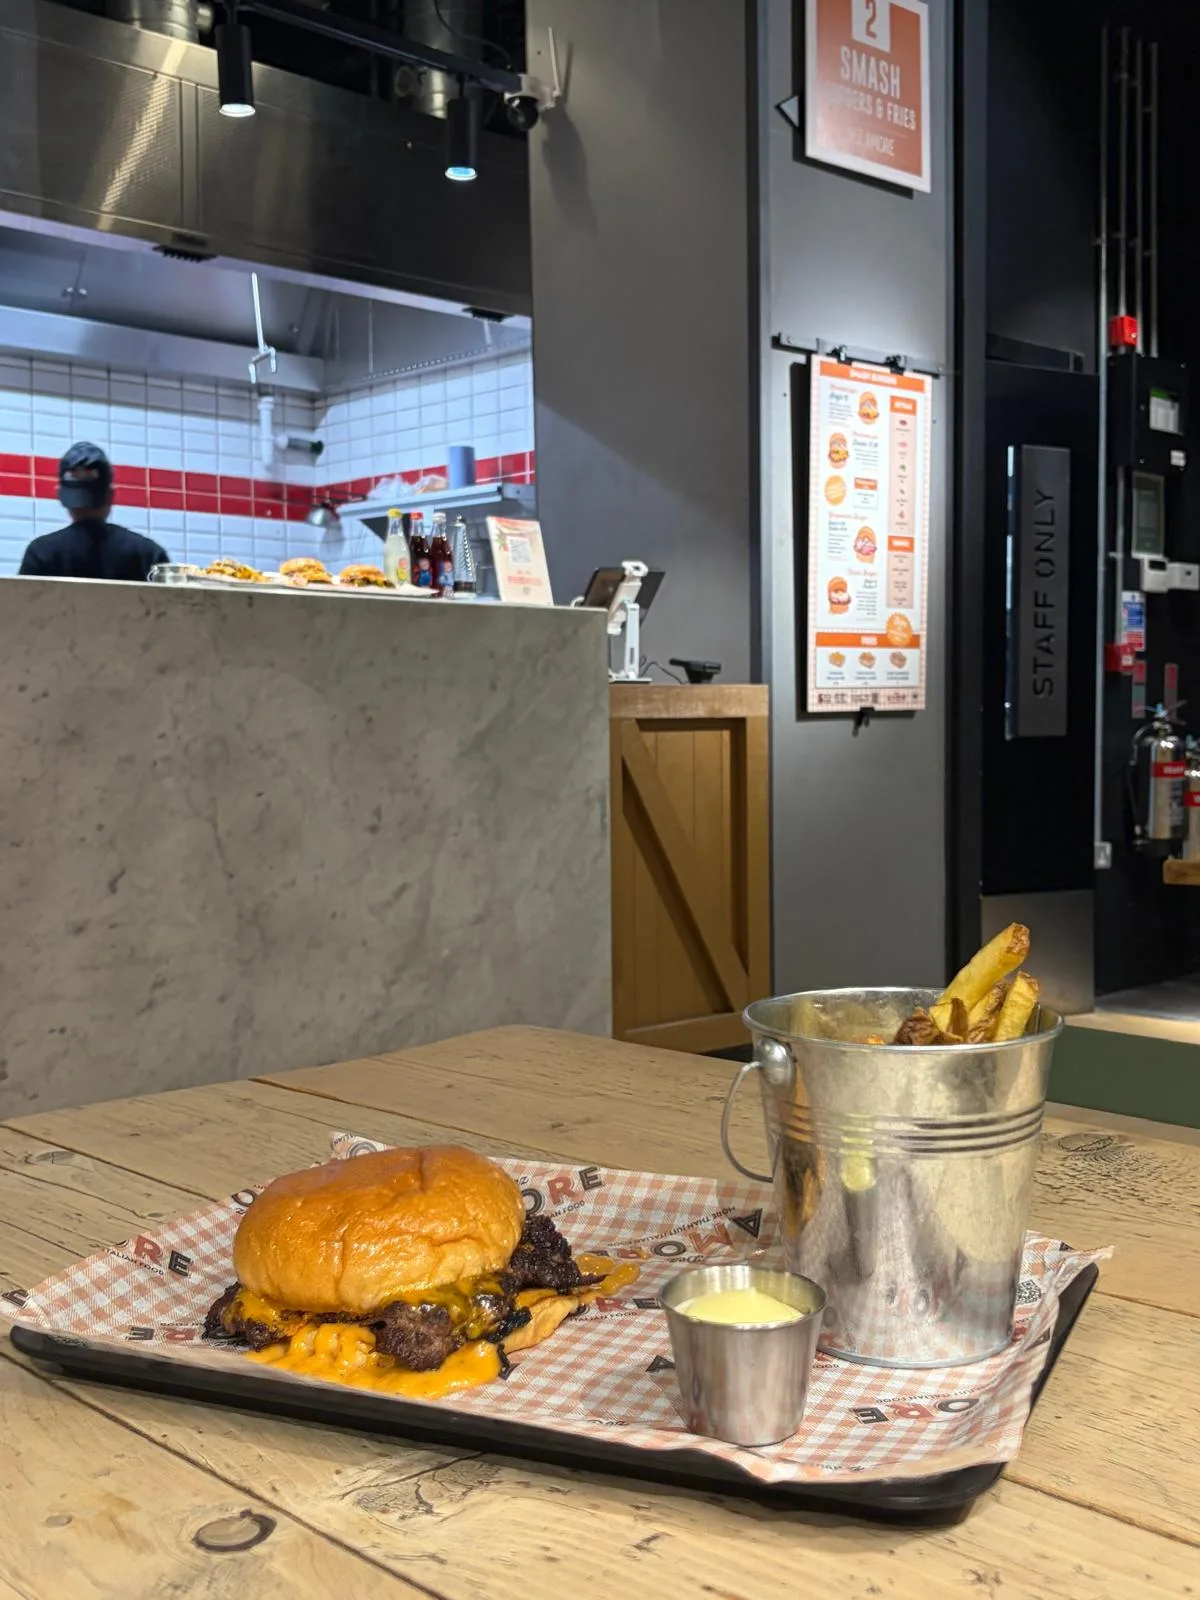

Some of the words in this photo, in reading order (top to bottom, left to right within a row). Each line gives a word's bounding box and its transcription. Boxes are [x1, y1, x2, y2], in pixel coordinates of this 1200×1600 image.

[865, 0, 877, 39] 2
[840, 46, 900, 99] SMASH
[887, 102, 916, 131] FRIES
[1034, 489, 1055, 578] ONLY
[1033, 589, 1055, 697] STAFF
